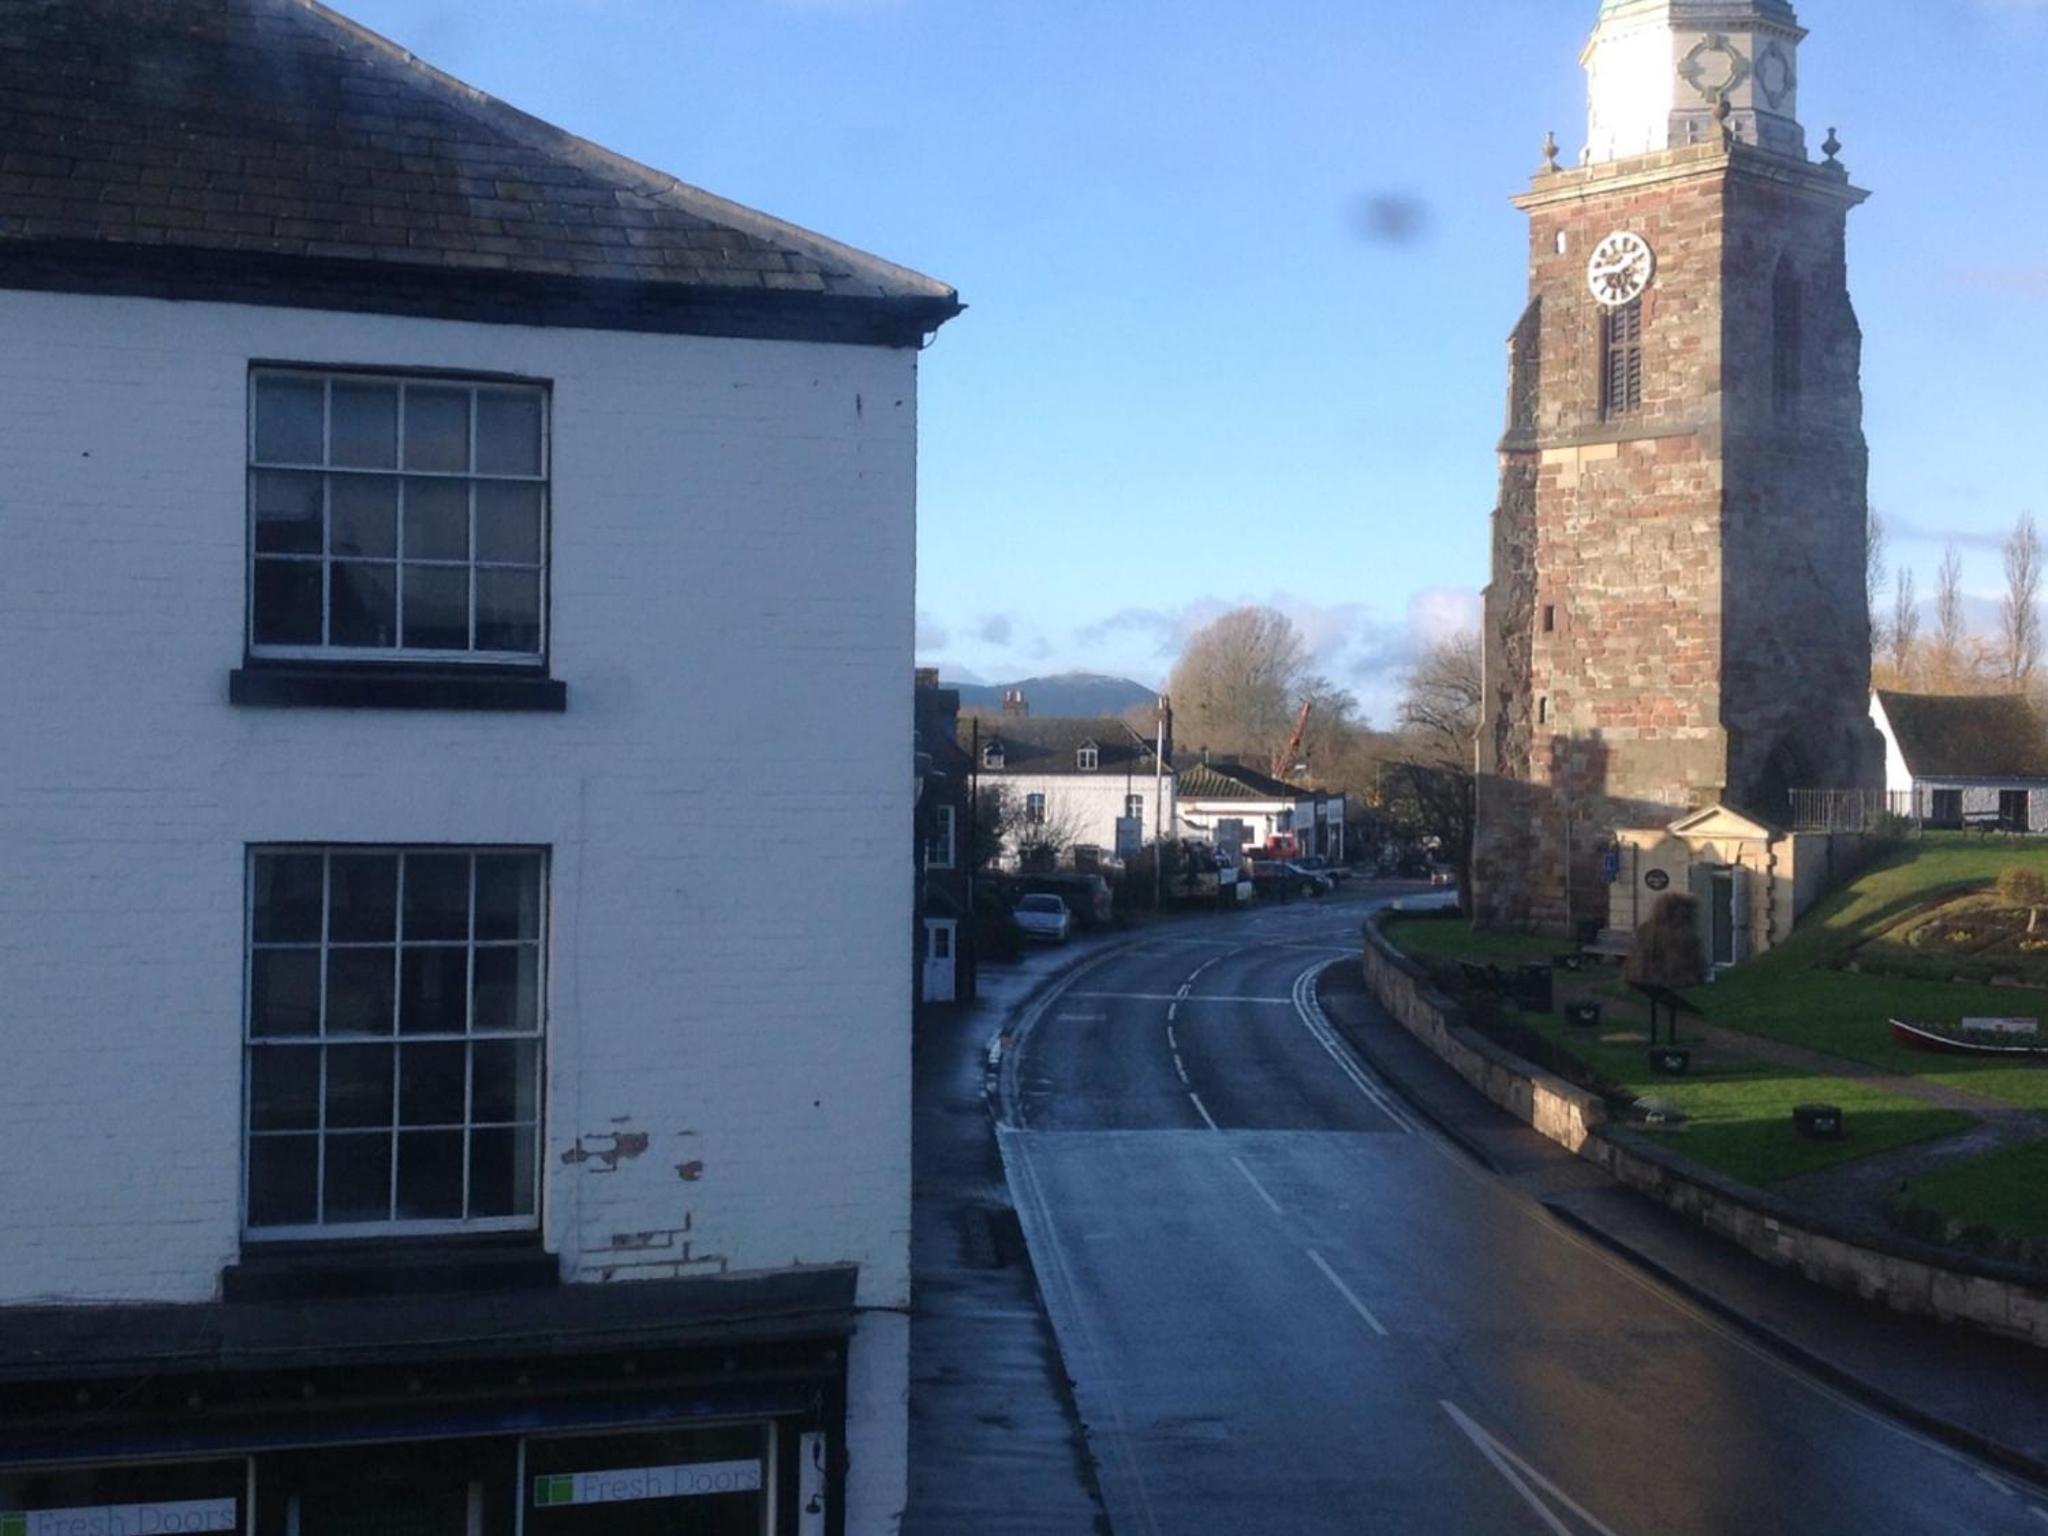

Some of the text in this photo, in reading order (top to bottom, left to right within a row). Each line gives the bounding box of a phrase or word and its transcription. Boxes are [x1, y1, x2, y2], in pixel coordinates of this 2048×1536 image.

[582, 1466, 759, 1501] Fresh Doors
[37, 1505, 234, 1536] Fresh Doors
